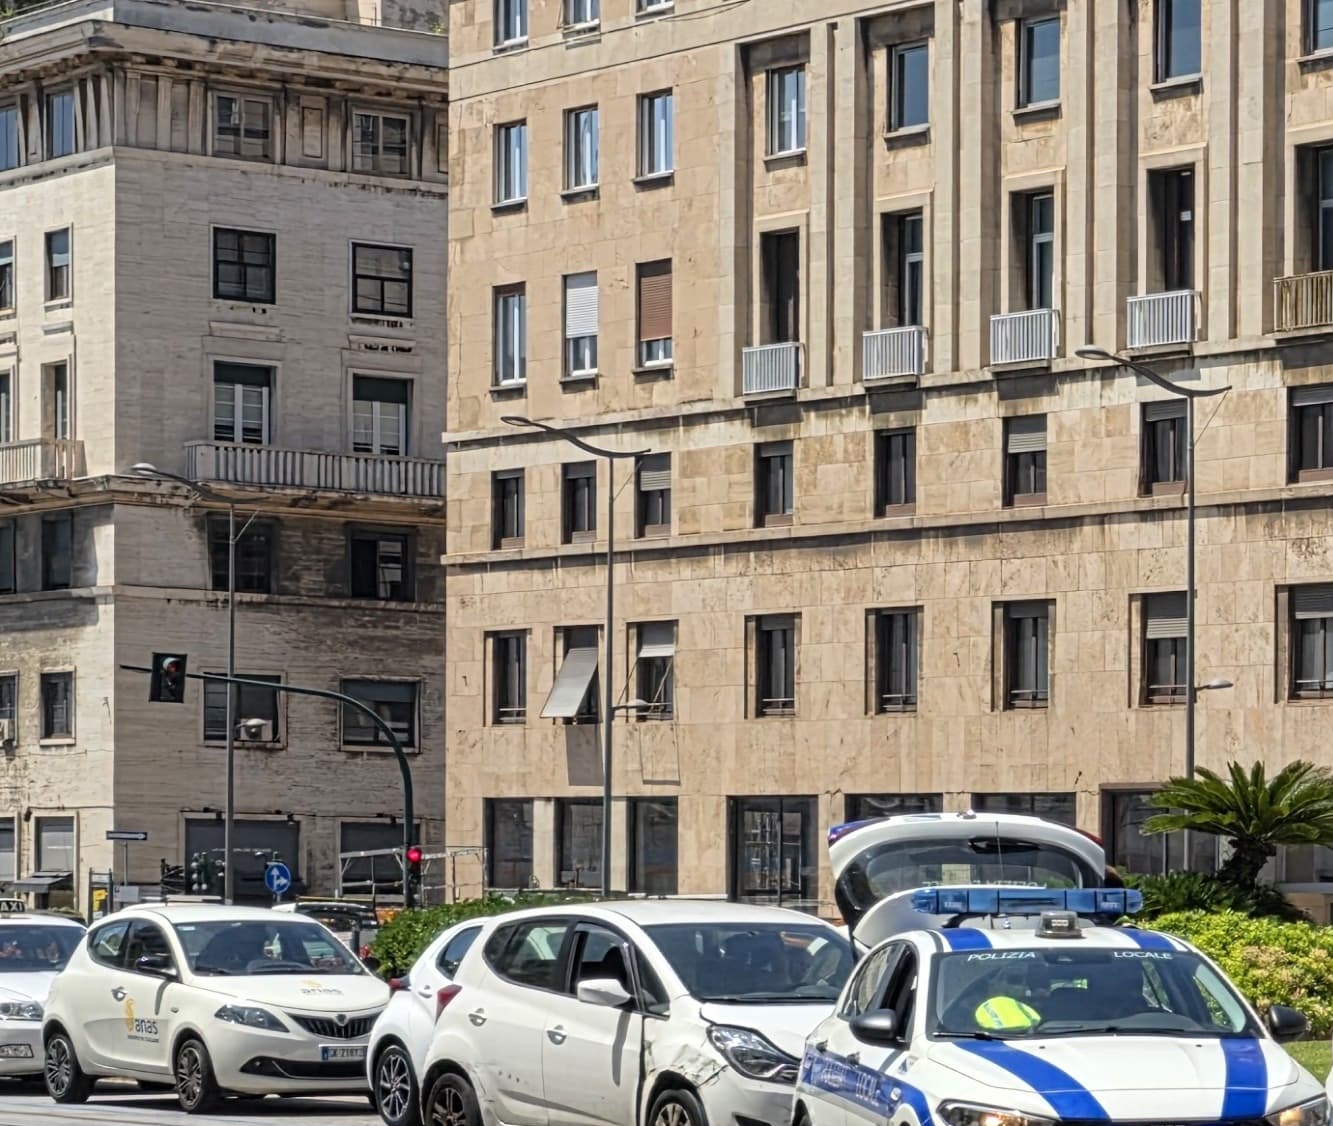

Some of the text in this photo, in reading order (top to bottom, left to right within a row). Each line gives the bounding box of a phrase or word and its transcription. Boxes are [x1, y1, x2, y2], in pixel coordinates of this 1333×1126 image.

[0, 901, 23, 912] AXI
[967, 951, 1174, 962] POLIZIA LOCALE
[134, 1018, 159, 1036] anas
